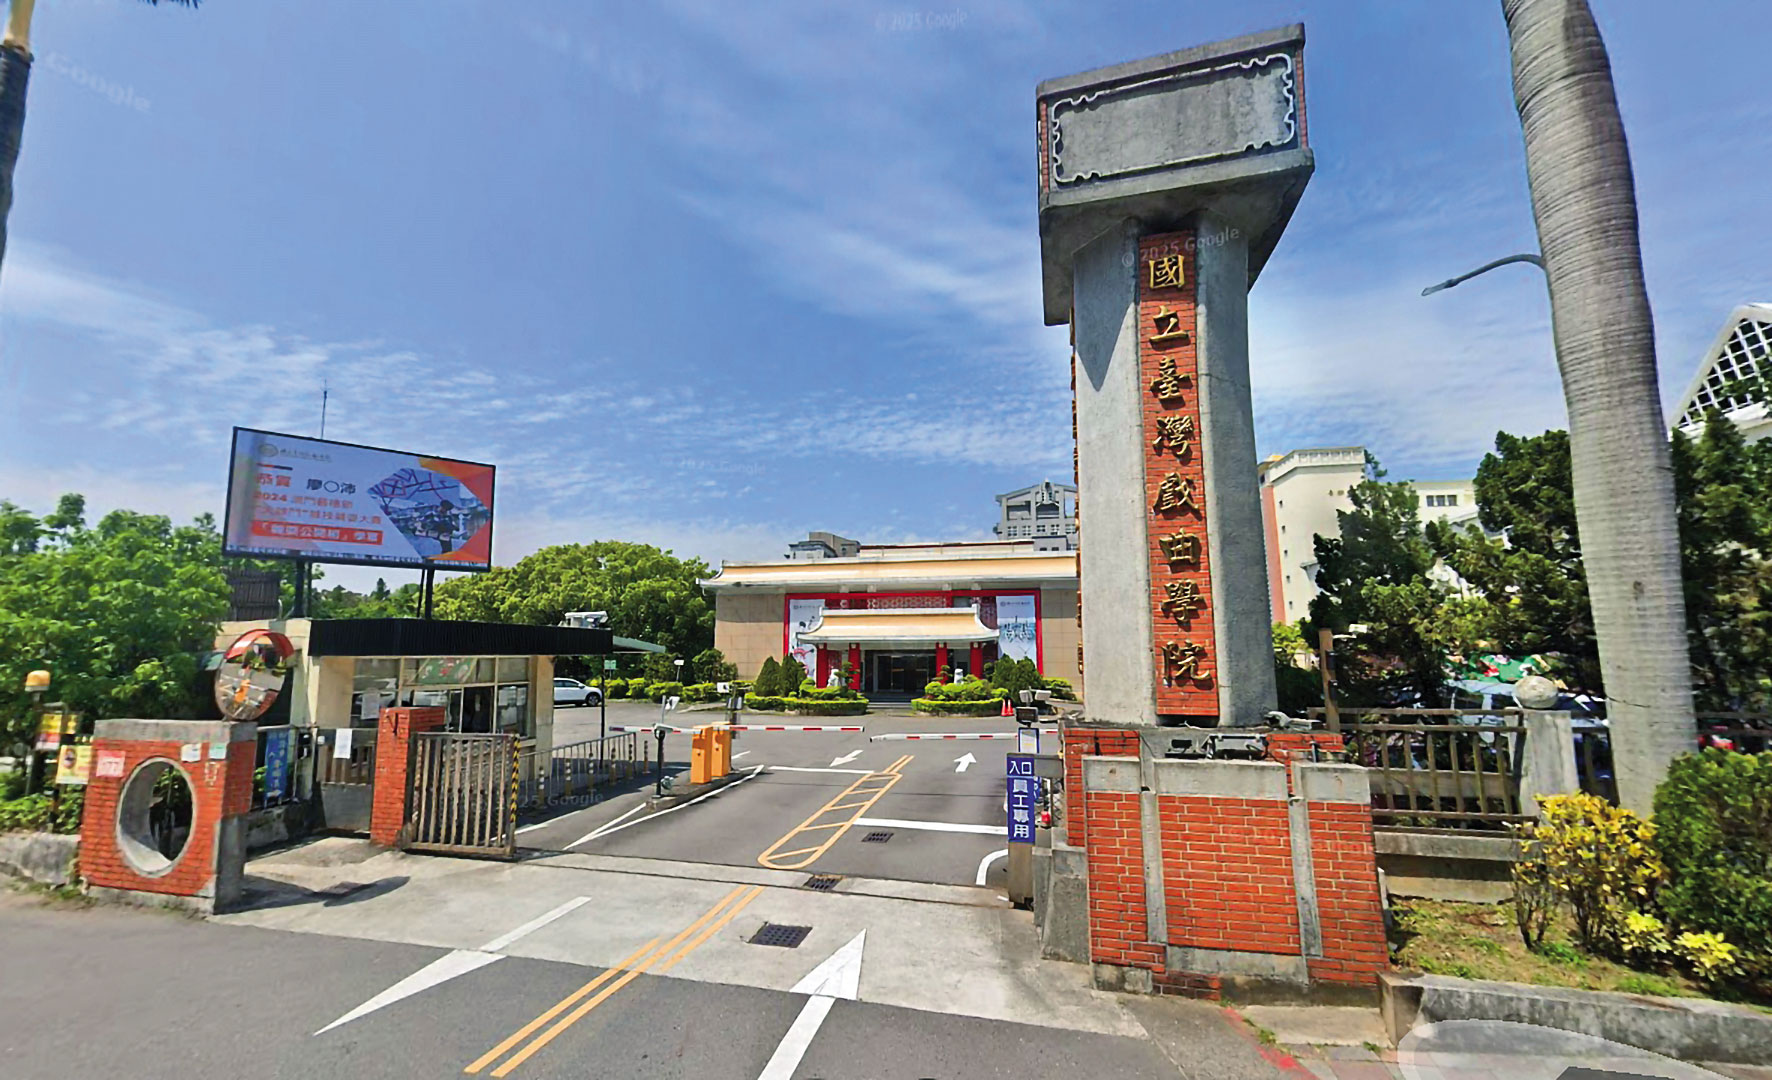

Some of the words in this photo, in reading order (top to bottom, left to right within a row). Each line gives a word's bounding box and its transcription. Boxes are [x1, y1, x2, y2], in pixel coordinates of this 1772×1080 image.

[253, 490, 287, 503] 2024
[1009, 760, 1032, 775] 入口
[1011, 779, 1030, 838] 員工專用
